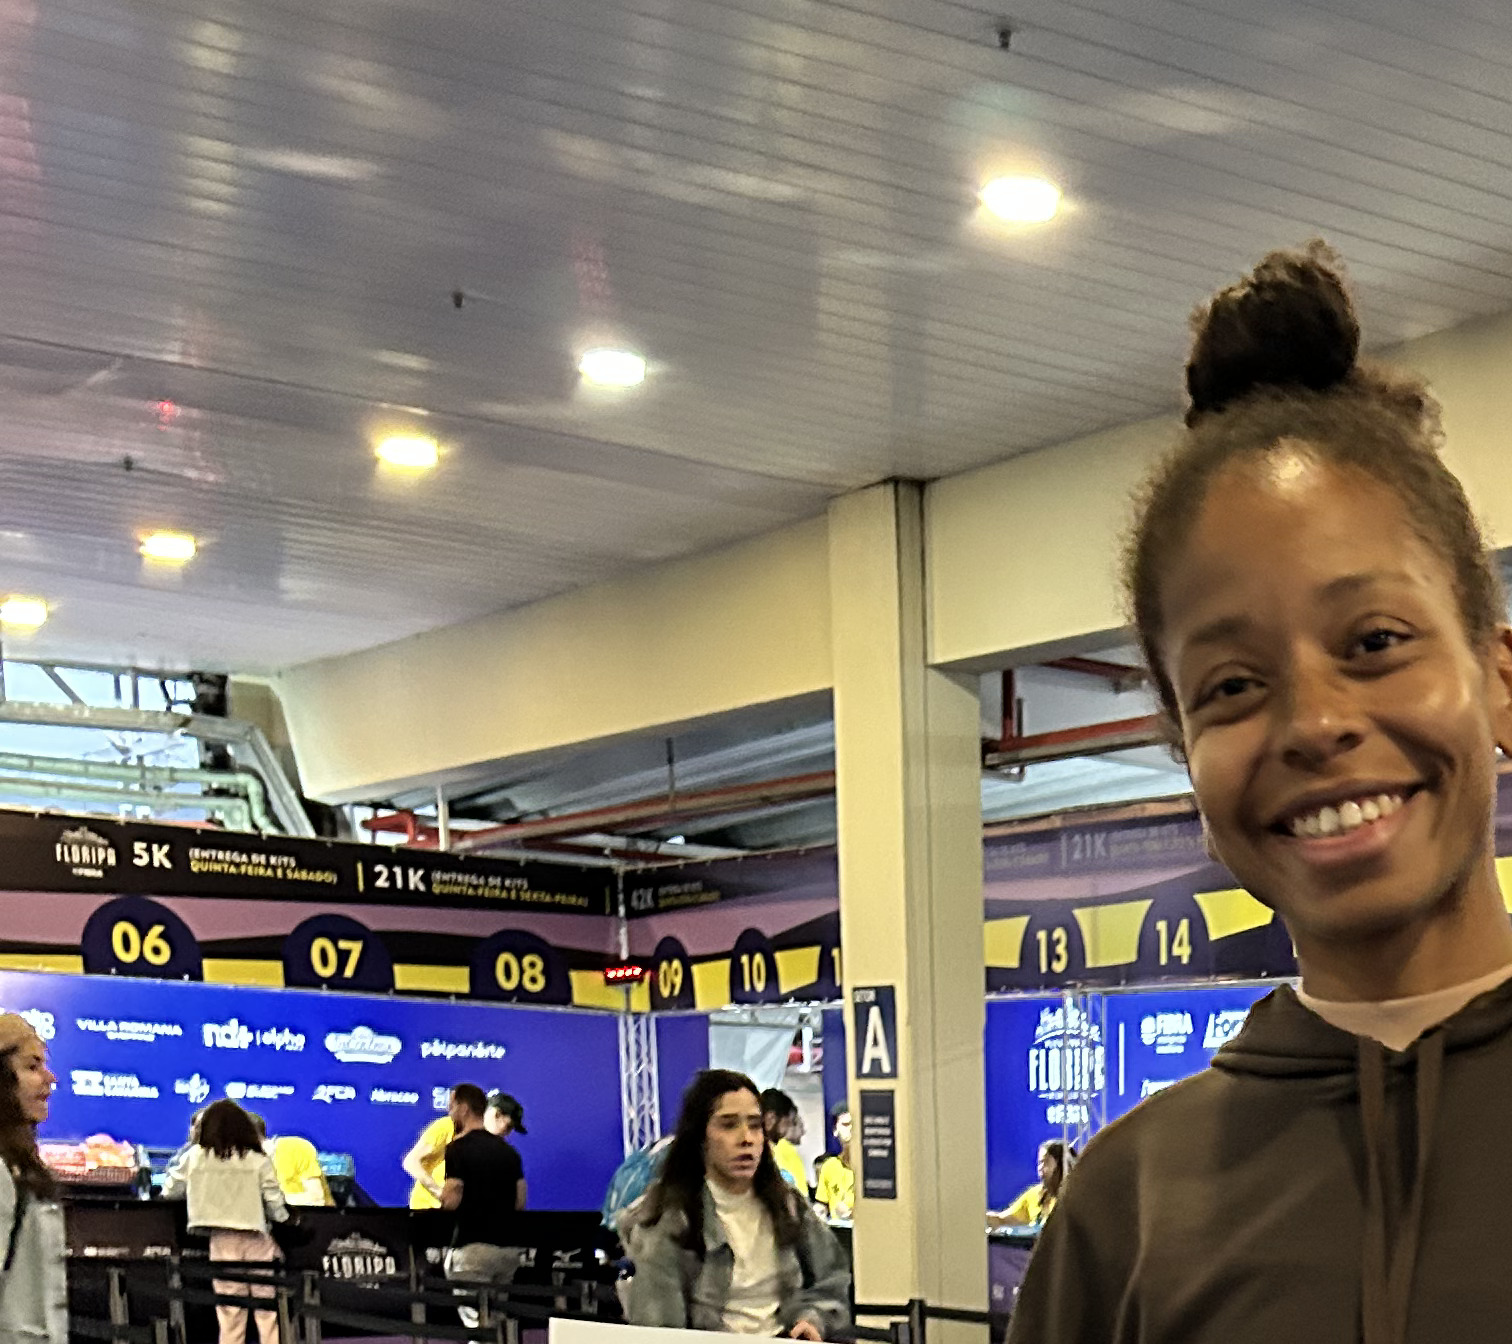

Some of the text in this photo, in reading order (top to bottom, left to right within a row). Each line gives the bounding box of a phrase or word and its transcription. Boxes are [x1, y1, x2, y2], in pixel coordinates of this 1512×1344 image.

[132, 841, 173, 869] 5K
[1072, 832, 1109, 861] 21K
[374, 864, 426, 893] 21K
[111, 921, 172, 966] 06
[310, 936, 364, 978] 07
[1036, 927, 1068, 973] 13
[1156, 918, 1191, 966] 14
[495, 952, 546, 993] 08
[659, 958, 683, 998] 09
[740, 952, 766, 993] 10
[861, 1005, 892, 1074] A
